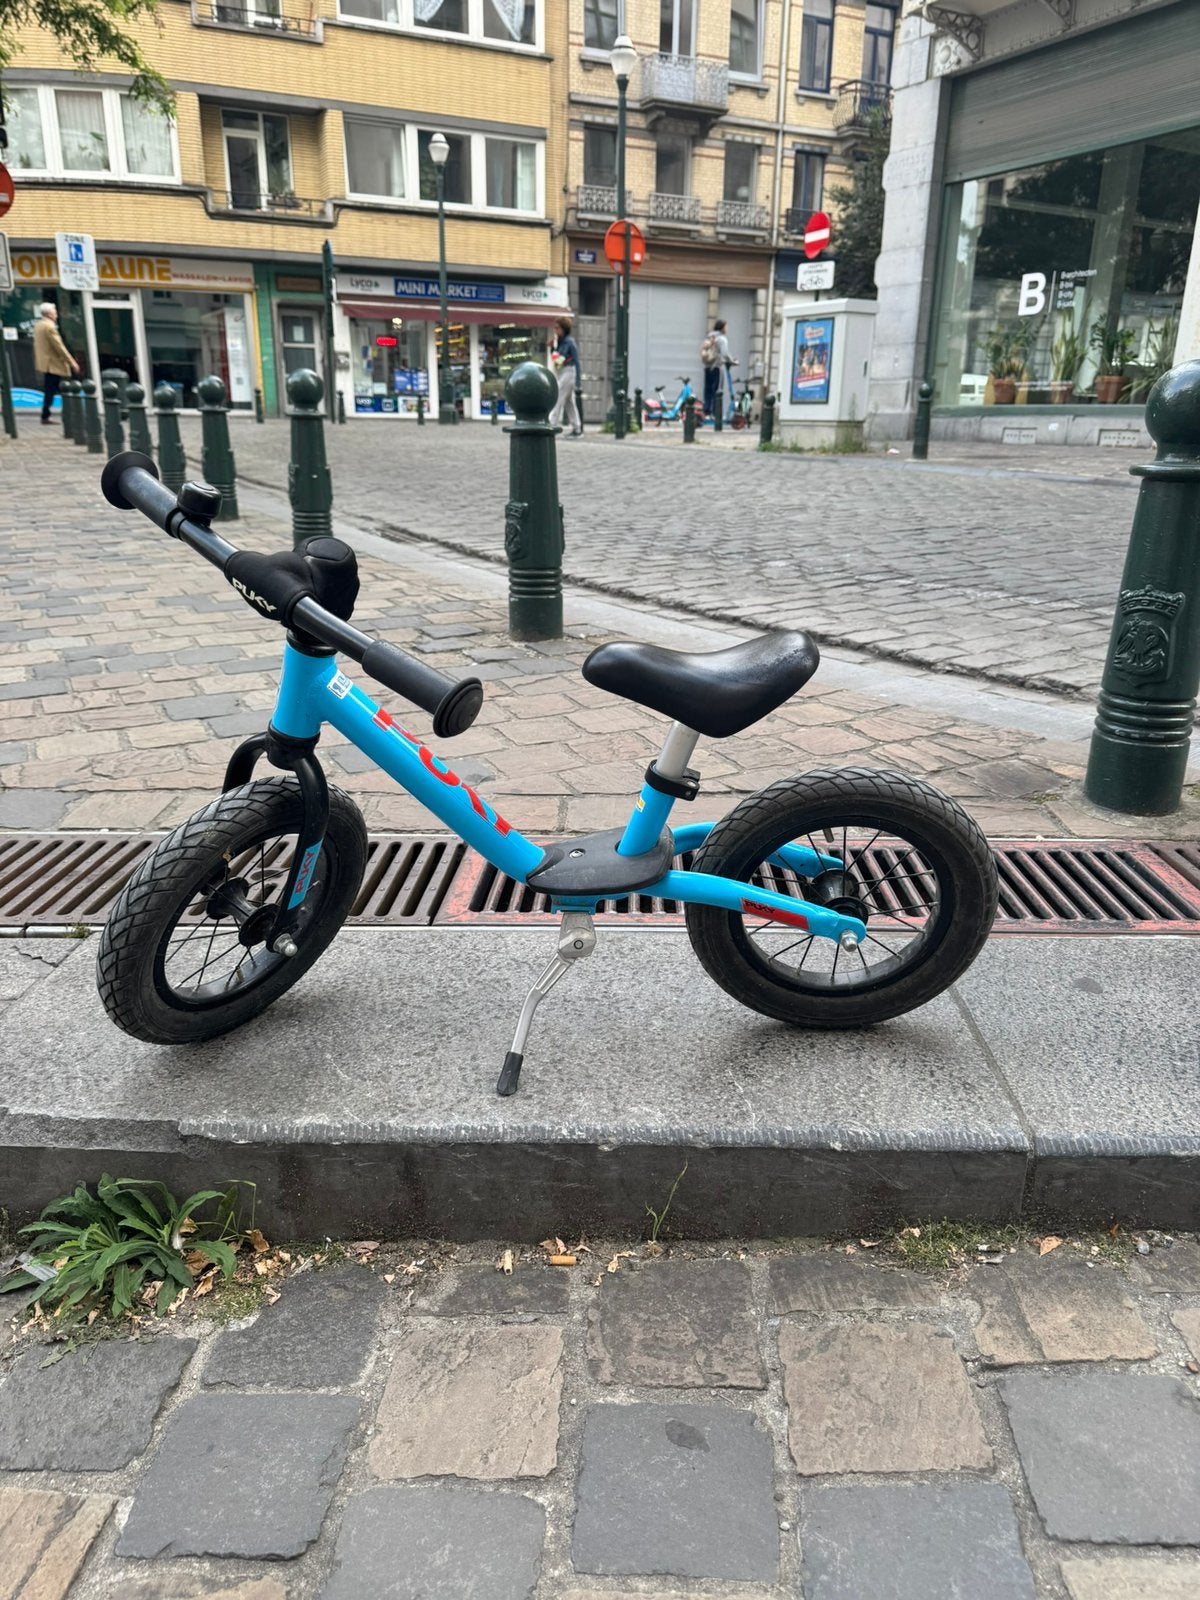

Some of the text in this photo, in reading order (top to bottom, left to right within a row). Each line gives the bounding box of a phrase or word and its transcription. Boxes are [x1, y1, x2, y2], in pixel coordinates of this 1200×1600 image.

[100, 256, 171, 281] AUNE
[397, 281, 425, 294] MINI
[427, 283, 477, 298] MRKET
[1018, 272, 1046, 316] B
[232, 577, 277, 613] PUKY
